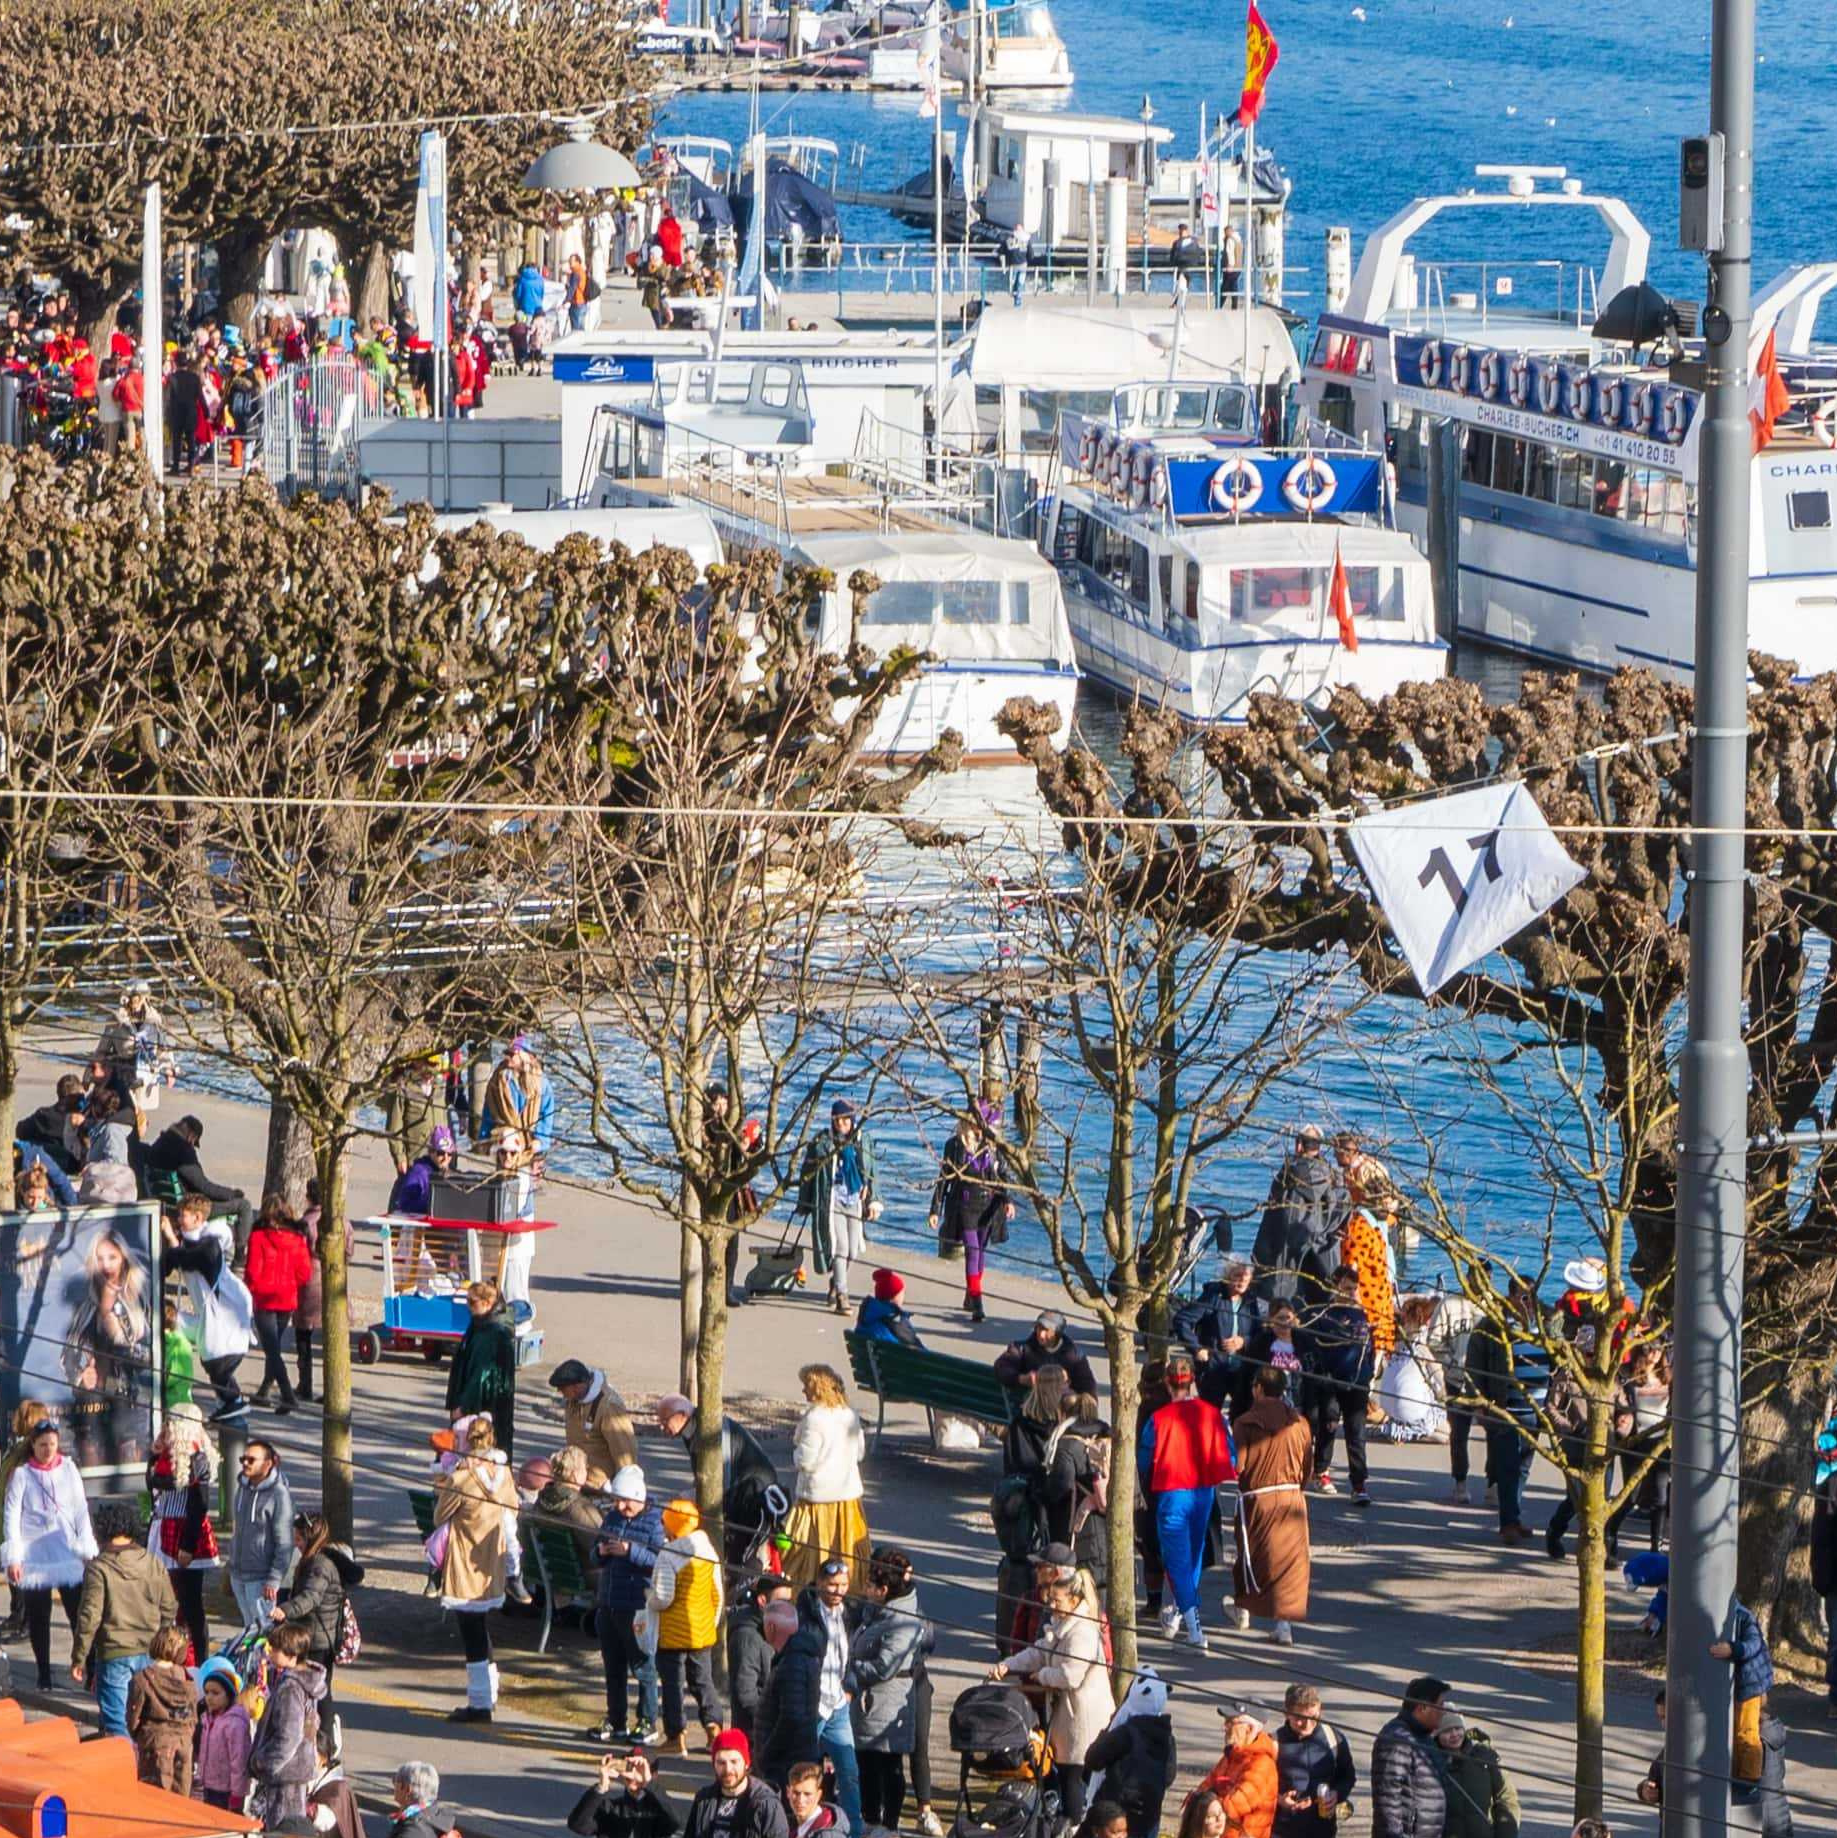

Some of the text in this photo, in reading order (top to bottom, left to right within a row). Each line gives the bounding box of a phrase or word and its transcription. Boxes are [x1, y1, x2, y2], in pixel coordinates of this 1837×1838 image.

[811, 358, 899, 369] BUCHER
[1477, 405, 1580, 442] CHARLES-BUCHER.CH
[1611, 437, 1624, 452] 41
[1626, 440, 1644, 457] 410
[1646, 444, 1660, 461] 20
